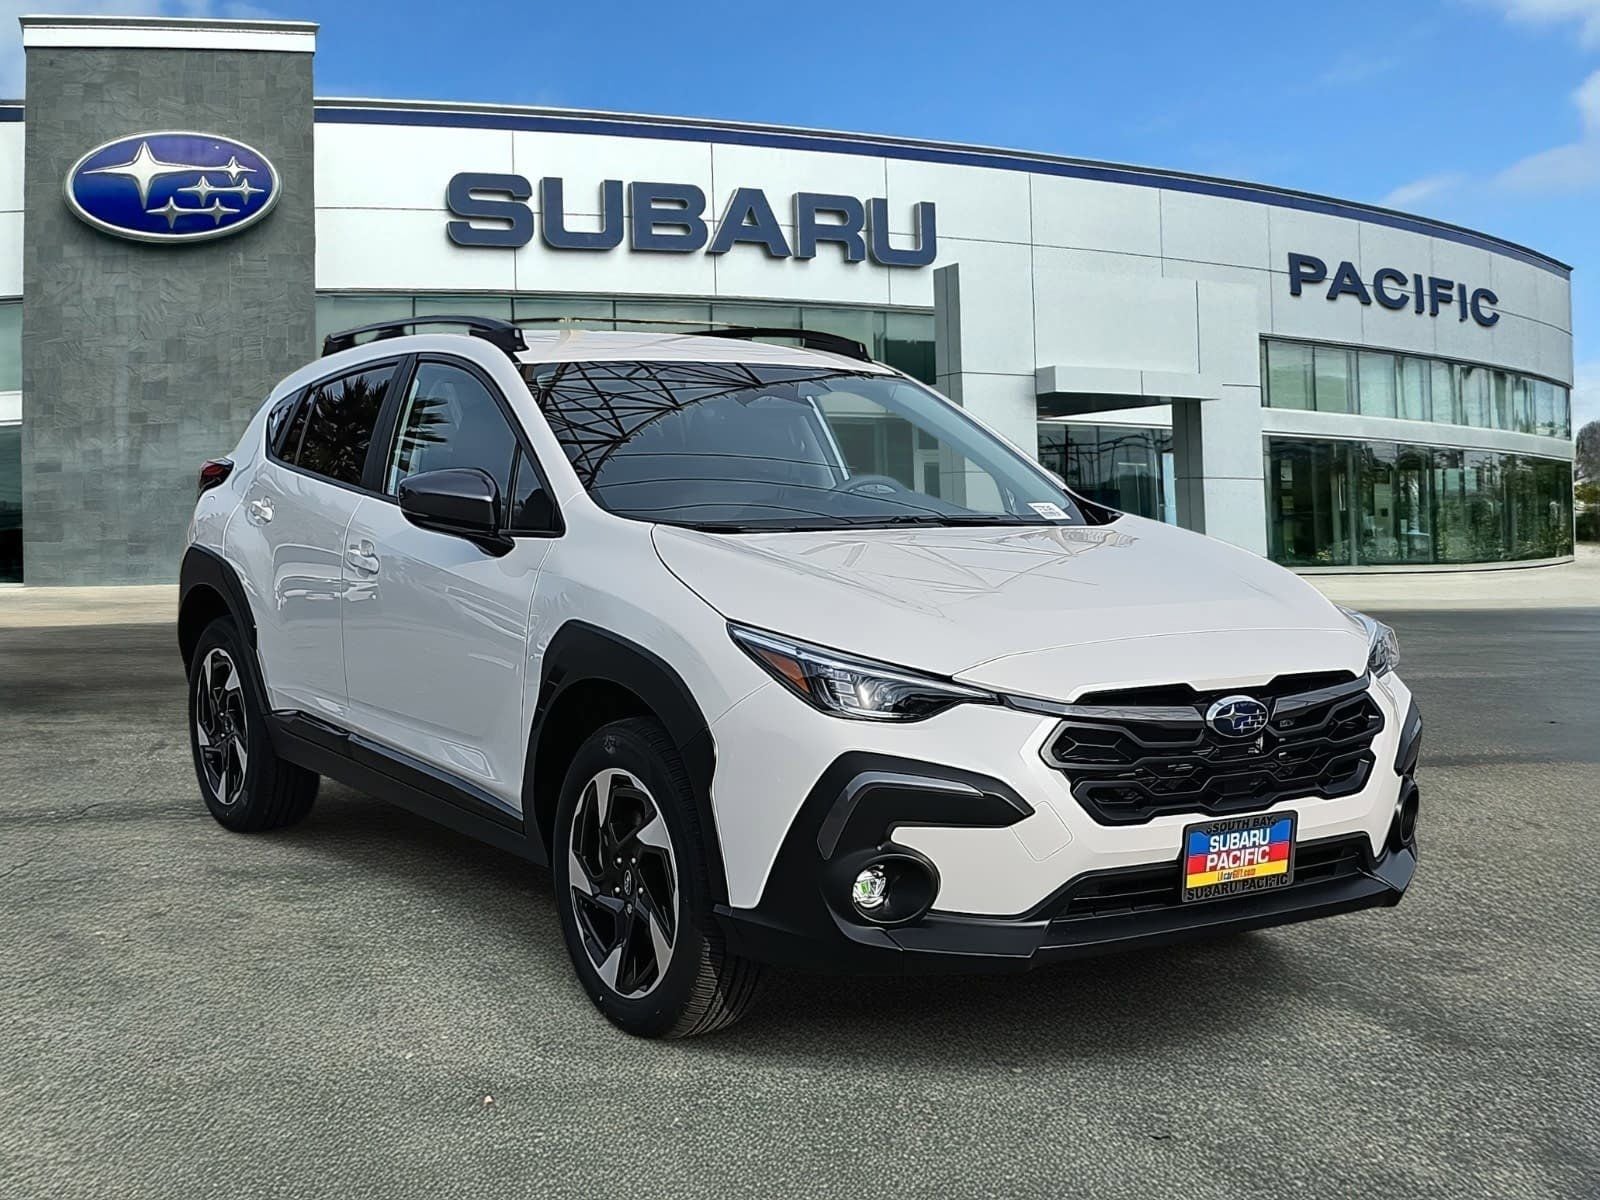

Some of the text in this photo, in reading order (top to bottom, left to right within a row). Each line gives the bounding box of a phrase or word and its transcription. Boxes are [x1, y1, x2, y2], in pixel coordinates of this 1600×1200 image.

[447, 172, 937, 268] SUBARU
[1288, 252, 1501, 328] PACIFIC
[1212, 816, 1272, 834] SOUTH BAY
[1209, 828, 1270, 853] SUBARU
[1206, 846, 1269, 872] PACIFIC
[1187, 874, 1288, 900] SUBARU PACIFIC
